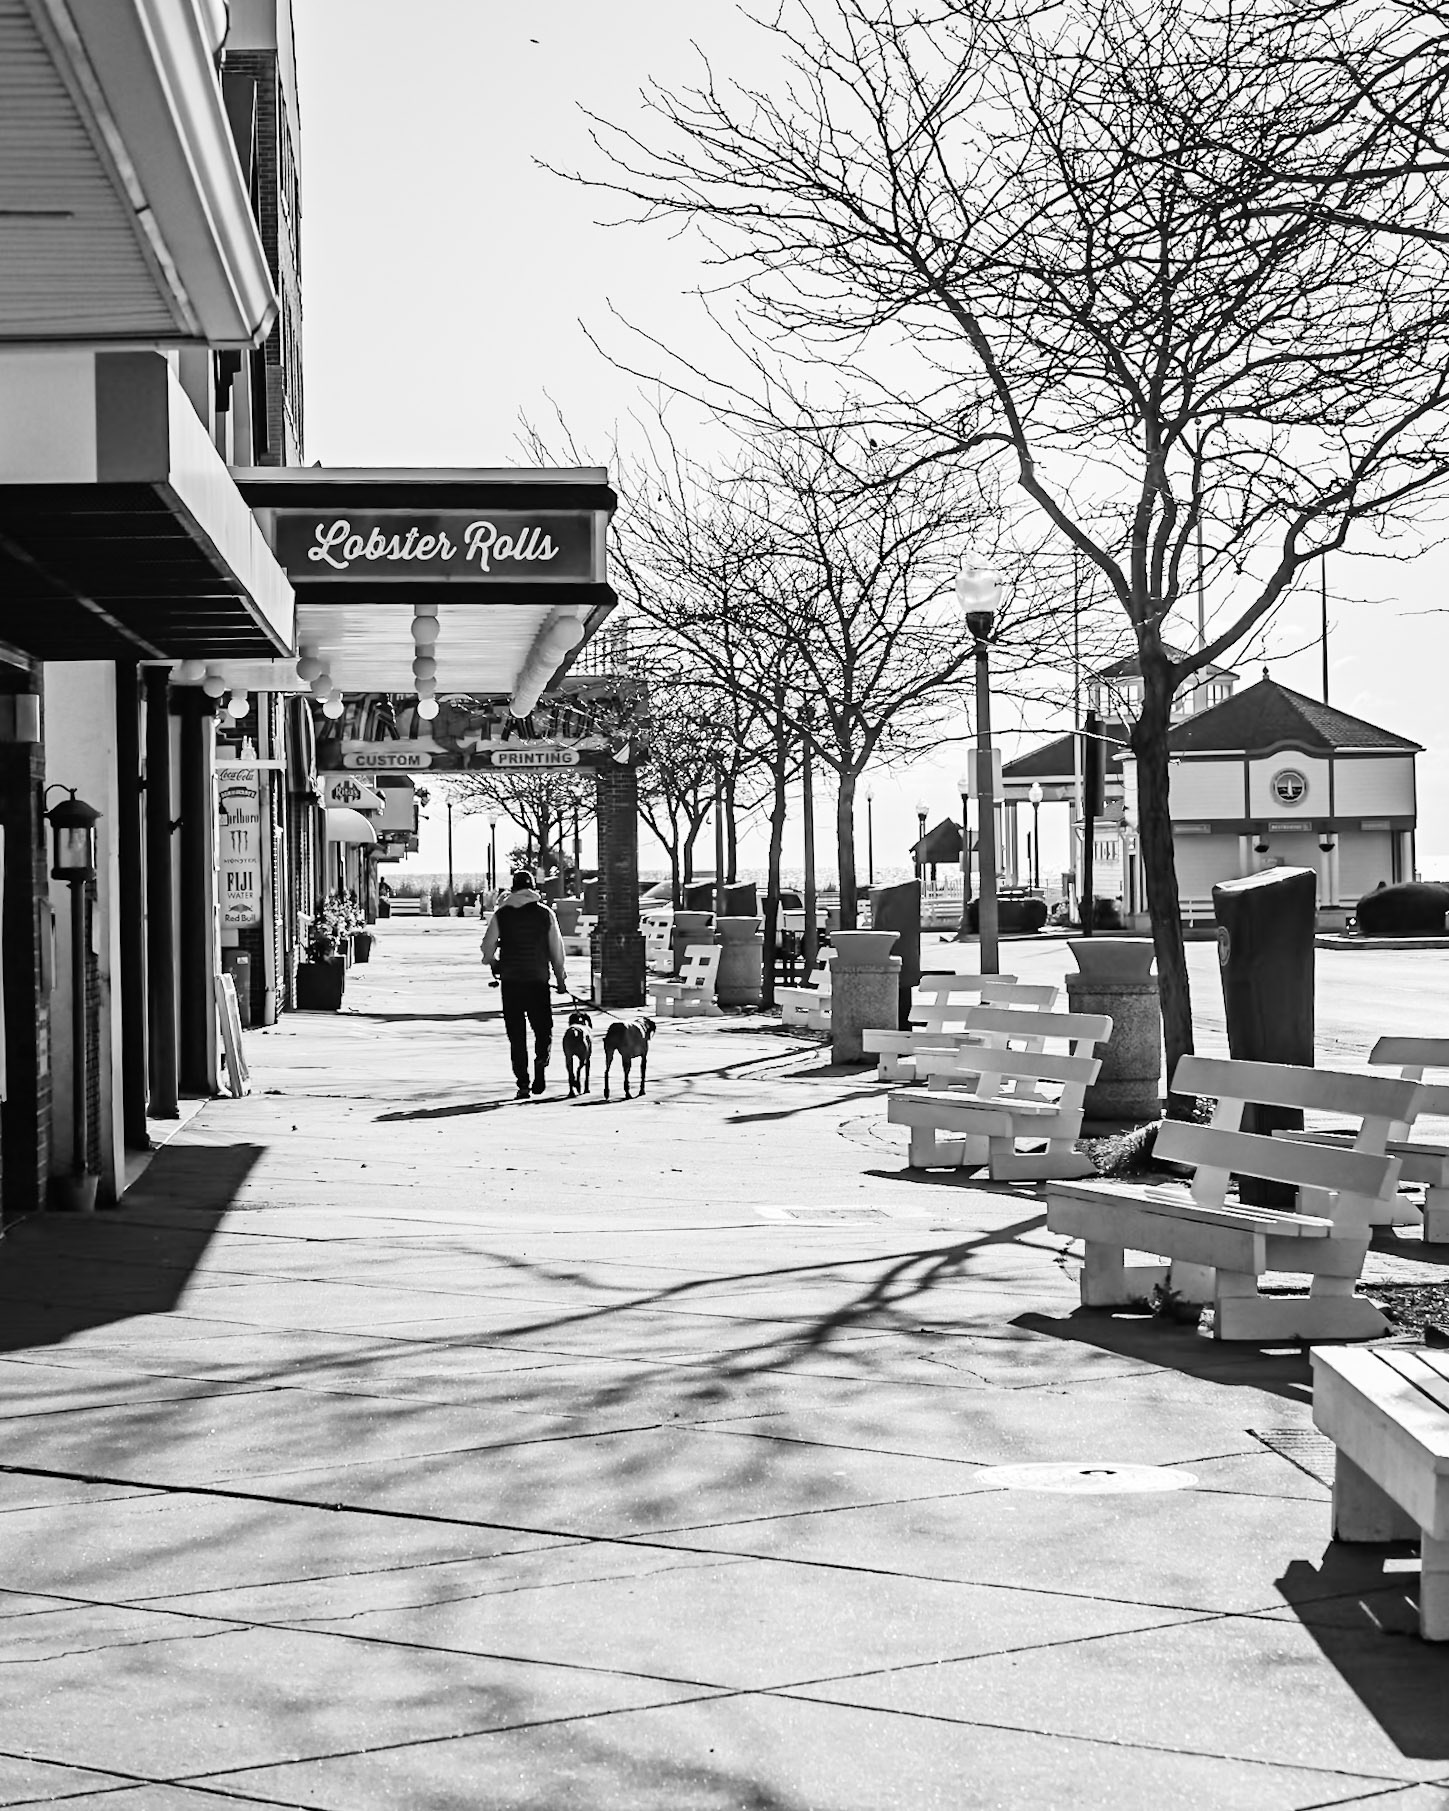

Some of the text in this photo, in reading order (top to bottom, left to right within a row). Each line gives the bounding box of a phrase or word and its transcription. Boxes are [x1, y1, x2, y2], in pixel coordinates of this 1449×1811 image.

[307, 519, 560, 573] Lobster Rolls
[355, 753, 572, 767] CUSTOM PRINTING
[228, 808, 259, 824] arlboro
[227, 871, 253, 891] FIJI
[225, 913, 256, 922] Red Bull
